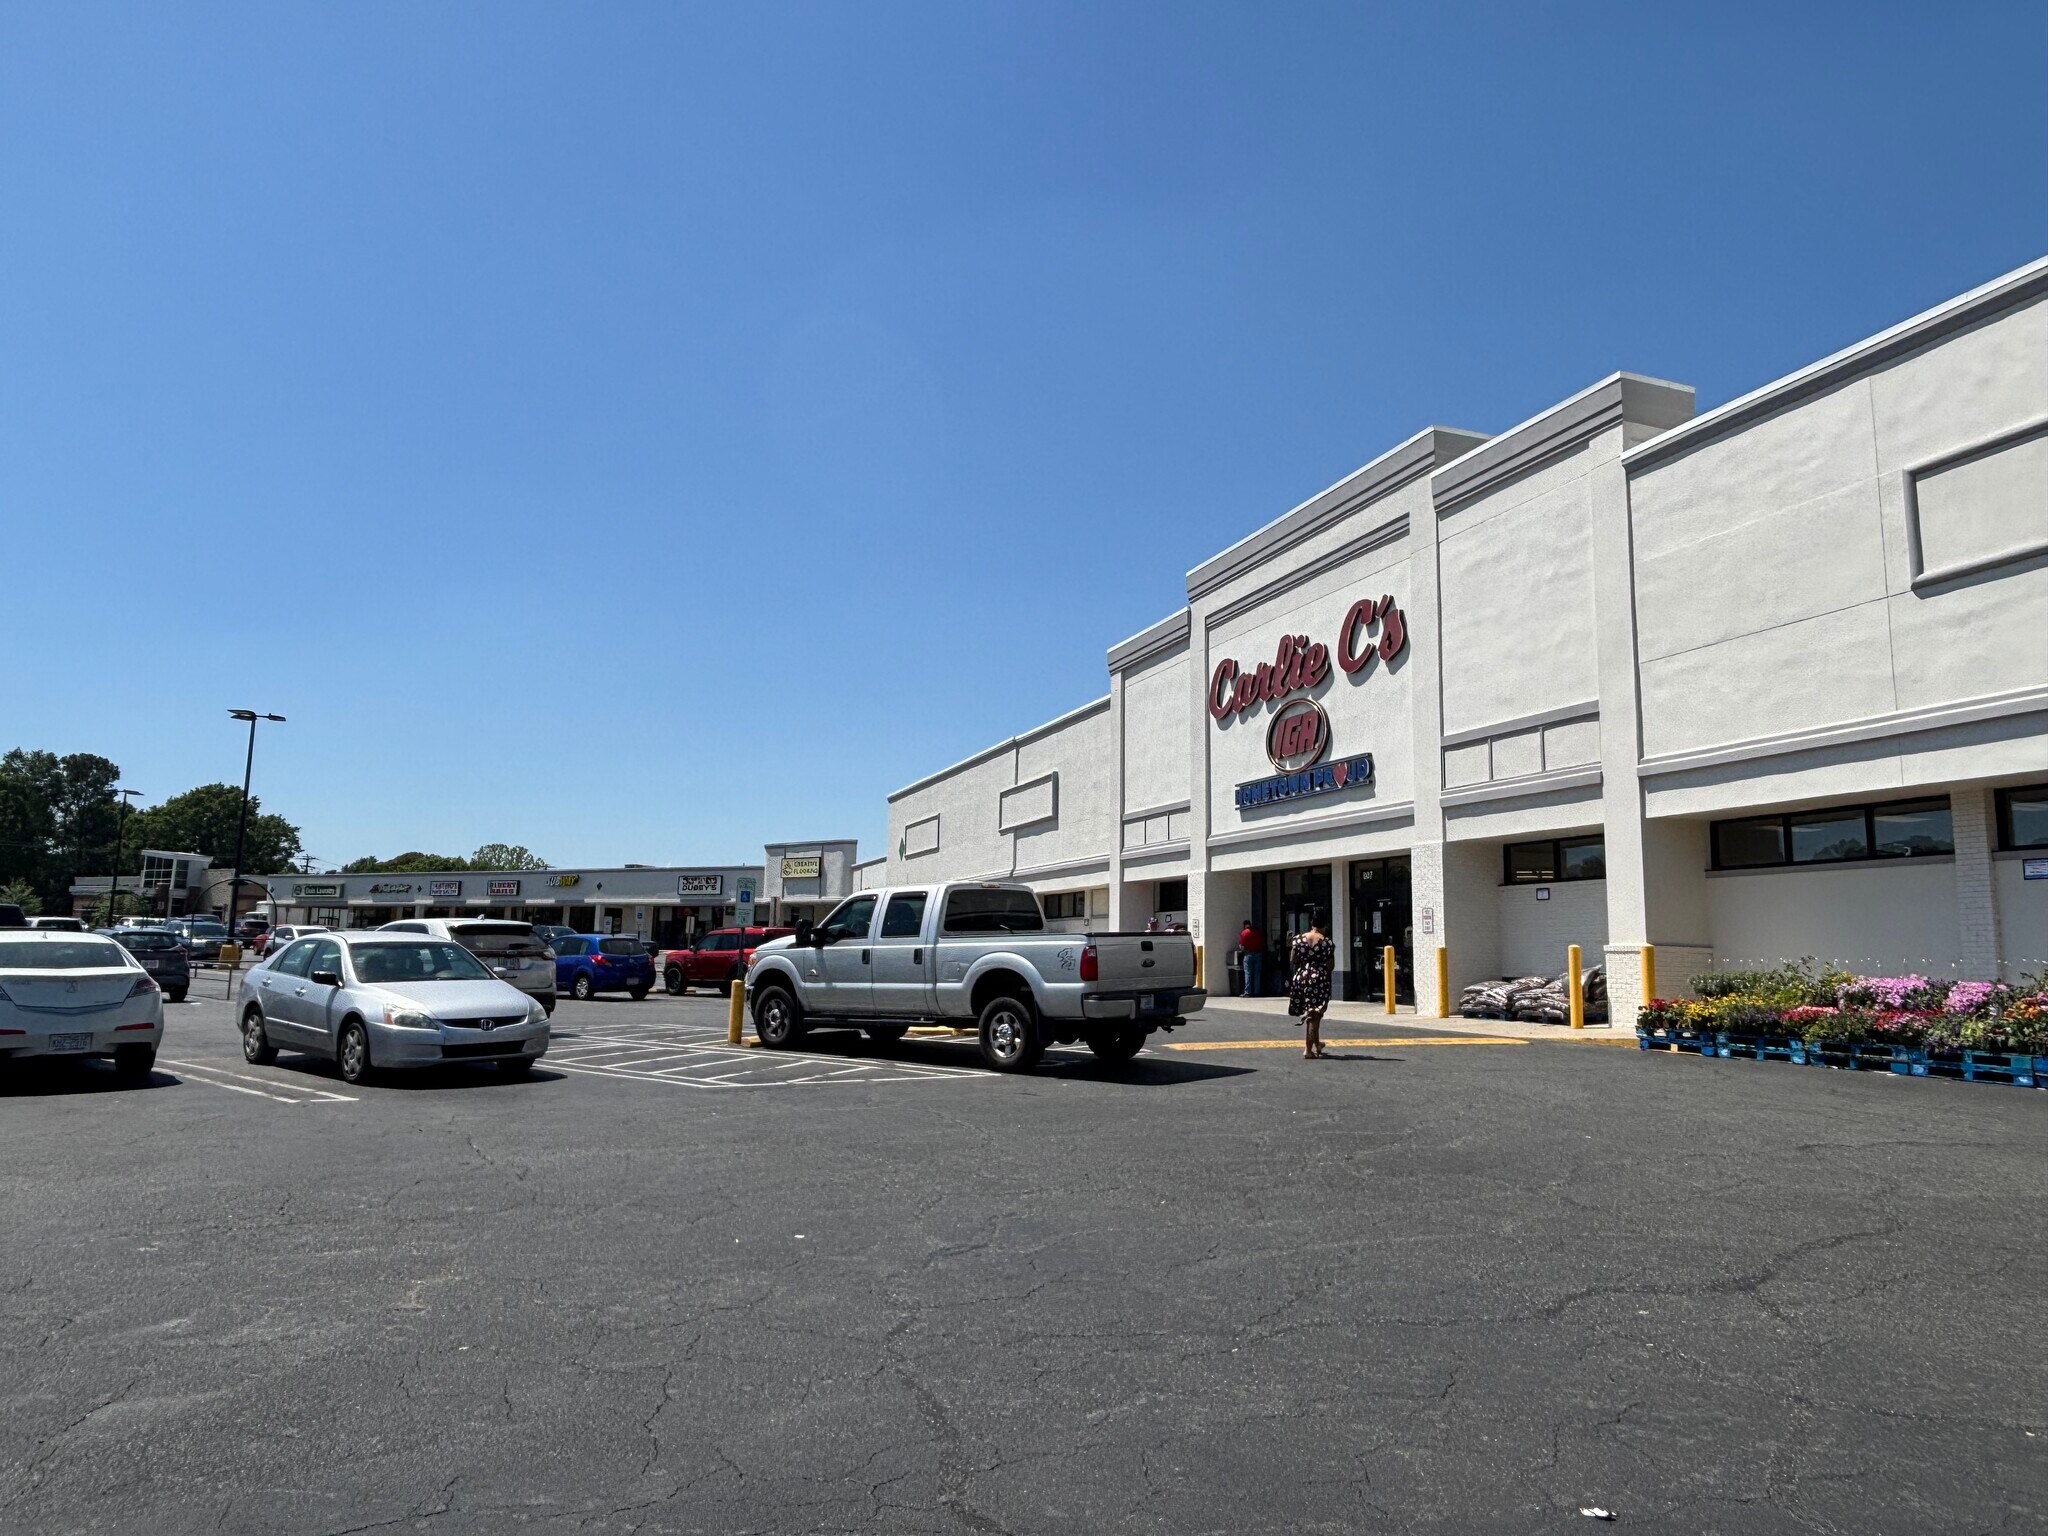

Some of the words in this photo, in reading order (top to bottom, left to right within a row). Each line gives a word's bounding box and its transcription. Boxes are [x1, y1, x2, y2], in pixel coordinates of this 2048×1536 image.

[1209, 634, 1328, 720] Carlie
[1338, 594, 1406, 673] C's
[1272, 710, 1319, 760] IGA
[545, 874, 579, 887] SUBWAY
